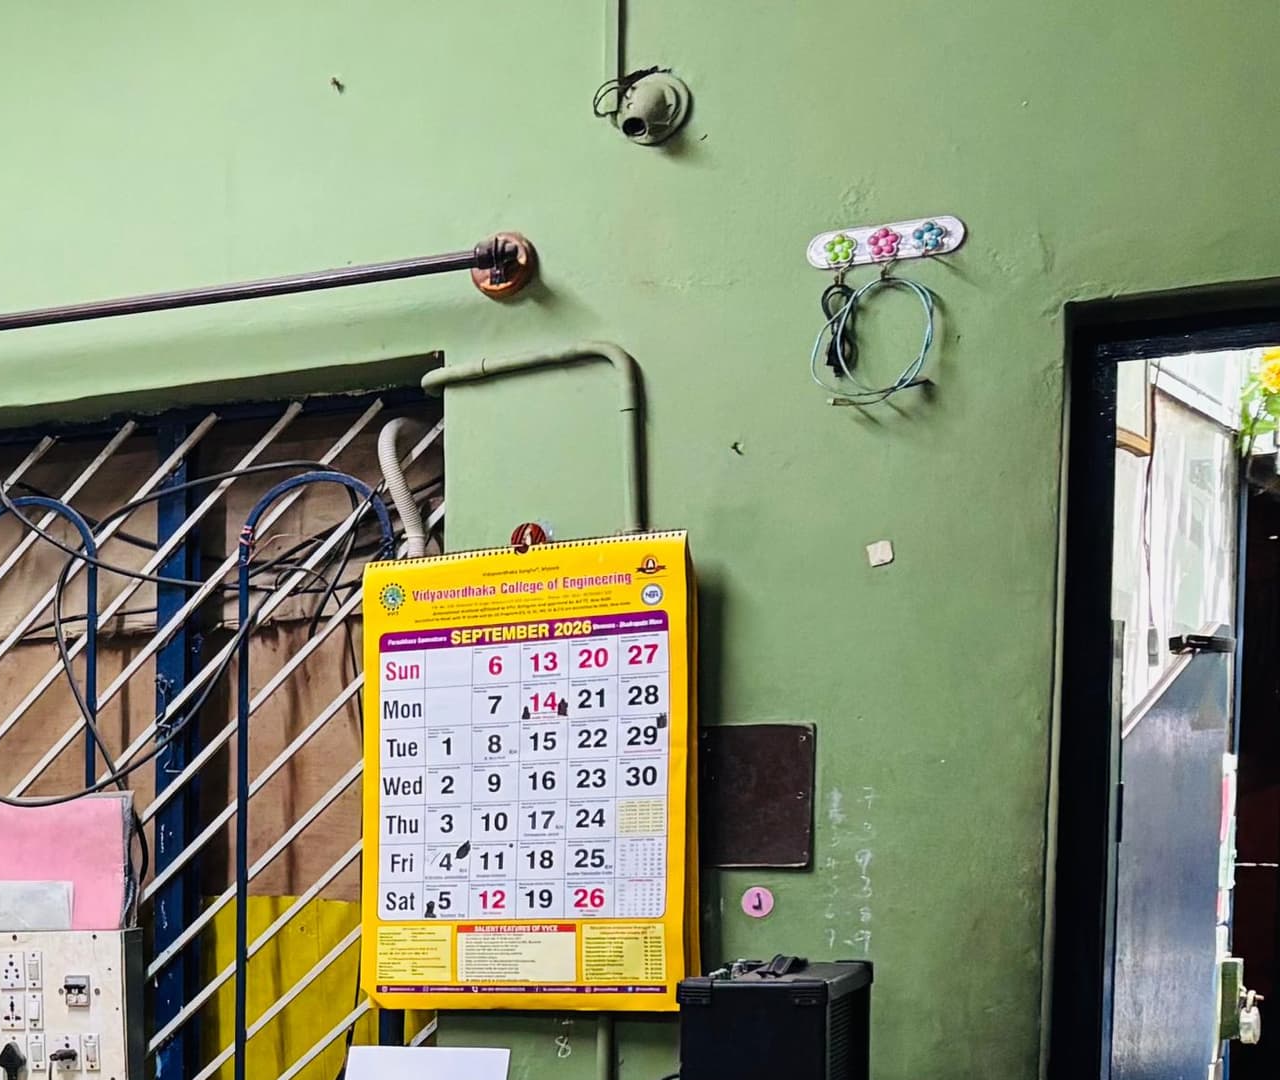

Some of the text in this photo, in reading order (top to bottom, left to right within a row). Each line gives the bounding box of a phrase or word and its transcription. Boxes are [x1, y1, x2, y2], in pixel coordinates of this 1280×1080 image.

[412, 572, 632, 603] Vidyavardhaka College of Engineering
[451, 622, 549, 645] SEPTEMBER
[555, 620, 592, 636] 2026
[531, 653, 558, 672] 13
[579, 648, 609, 668] 20
[628, 644, 659, 665] 27
[385, 662, 420, 682] Sun
[488, 655, 502, 675] 6
[488, 696, 502, 714] 7
[531, 692, 557, 711] 14
[578, 688, 606, 709] 21
[628, 685, 659, 705] 28
[383, 700, 423, 720] Mon
[488, 735, 502, 753] 8
[529, 732, 557, 751] 15
[577, 728, 607, 748] 22
[627, 726, 658, 746] 29
[386, 738, 418, 758] Tue
[442, 738, 452, 755] 1
[383, 775, 423, 797] Wed
[441, 776, 454, 794] 2
[488, 773, 501, 793] 9
[528, 771, 556, 791] 16
[576, 769, 607, 788] 23
[626, 766, 657, 786] 30
[386, 814, 419, 834] Thu
[440, 814, 454, 833] 3
[481, 812, 508, 831] 10
[528, 810, 555, 830] 17
[576, 808, 605, 828] 24
[390, 854, 414, 873] Fri
[439, 853, 452, 871] 4
[480, 851, 504, 870] 11
[526, 849, 554, 868] 18
[574, 849, 605, 868] 25
[386, 890, 416, 911] Sat
[438, 891, 451, 910] 5
[479, 890, 506, 910] 12
[525, 889, 553, 909] 19
[574, 888, 605, 908] 26
[555, 1036, 572, 1058] 8
